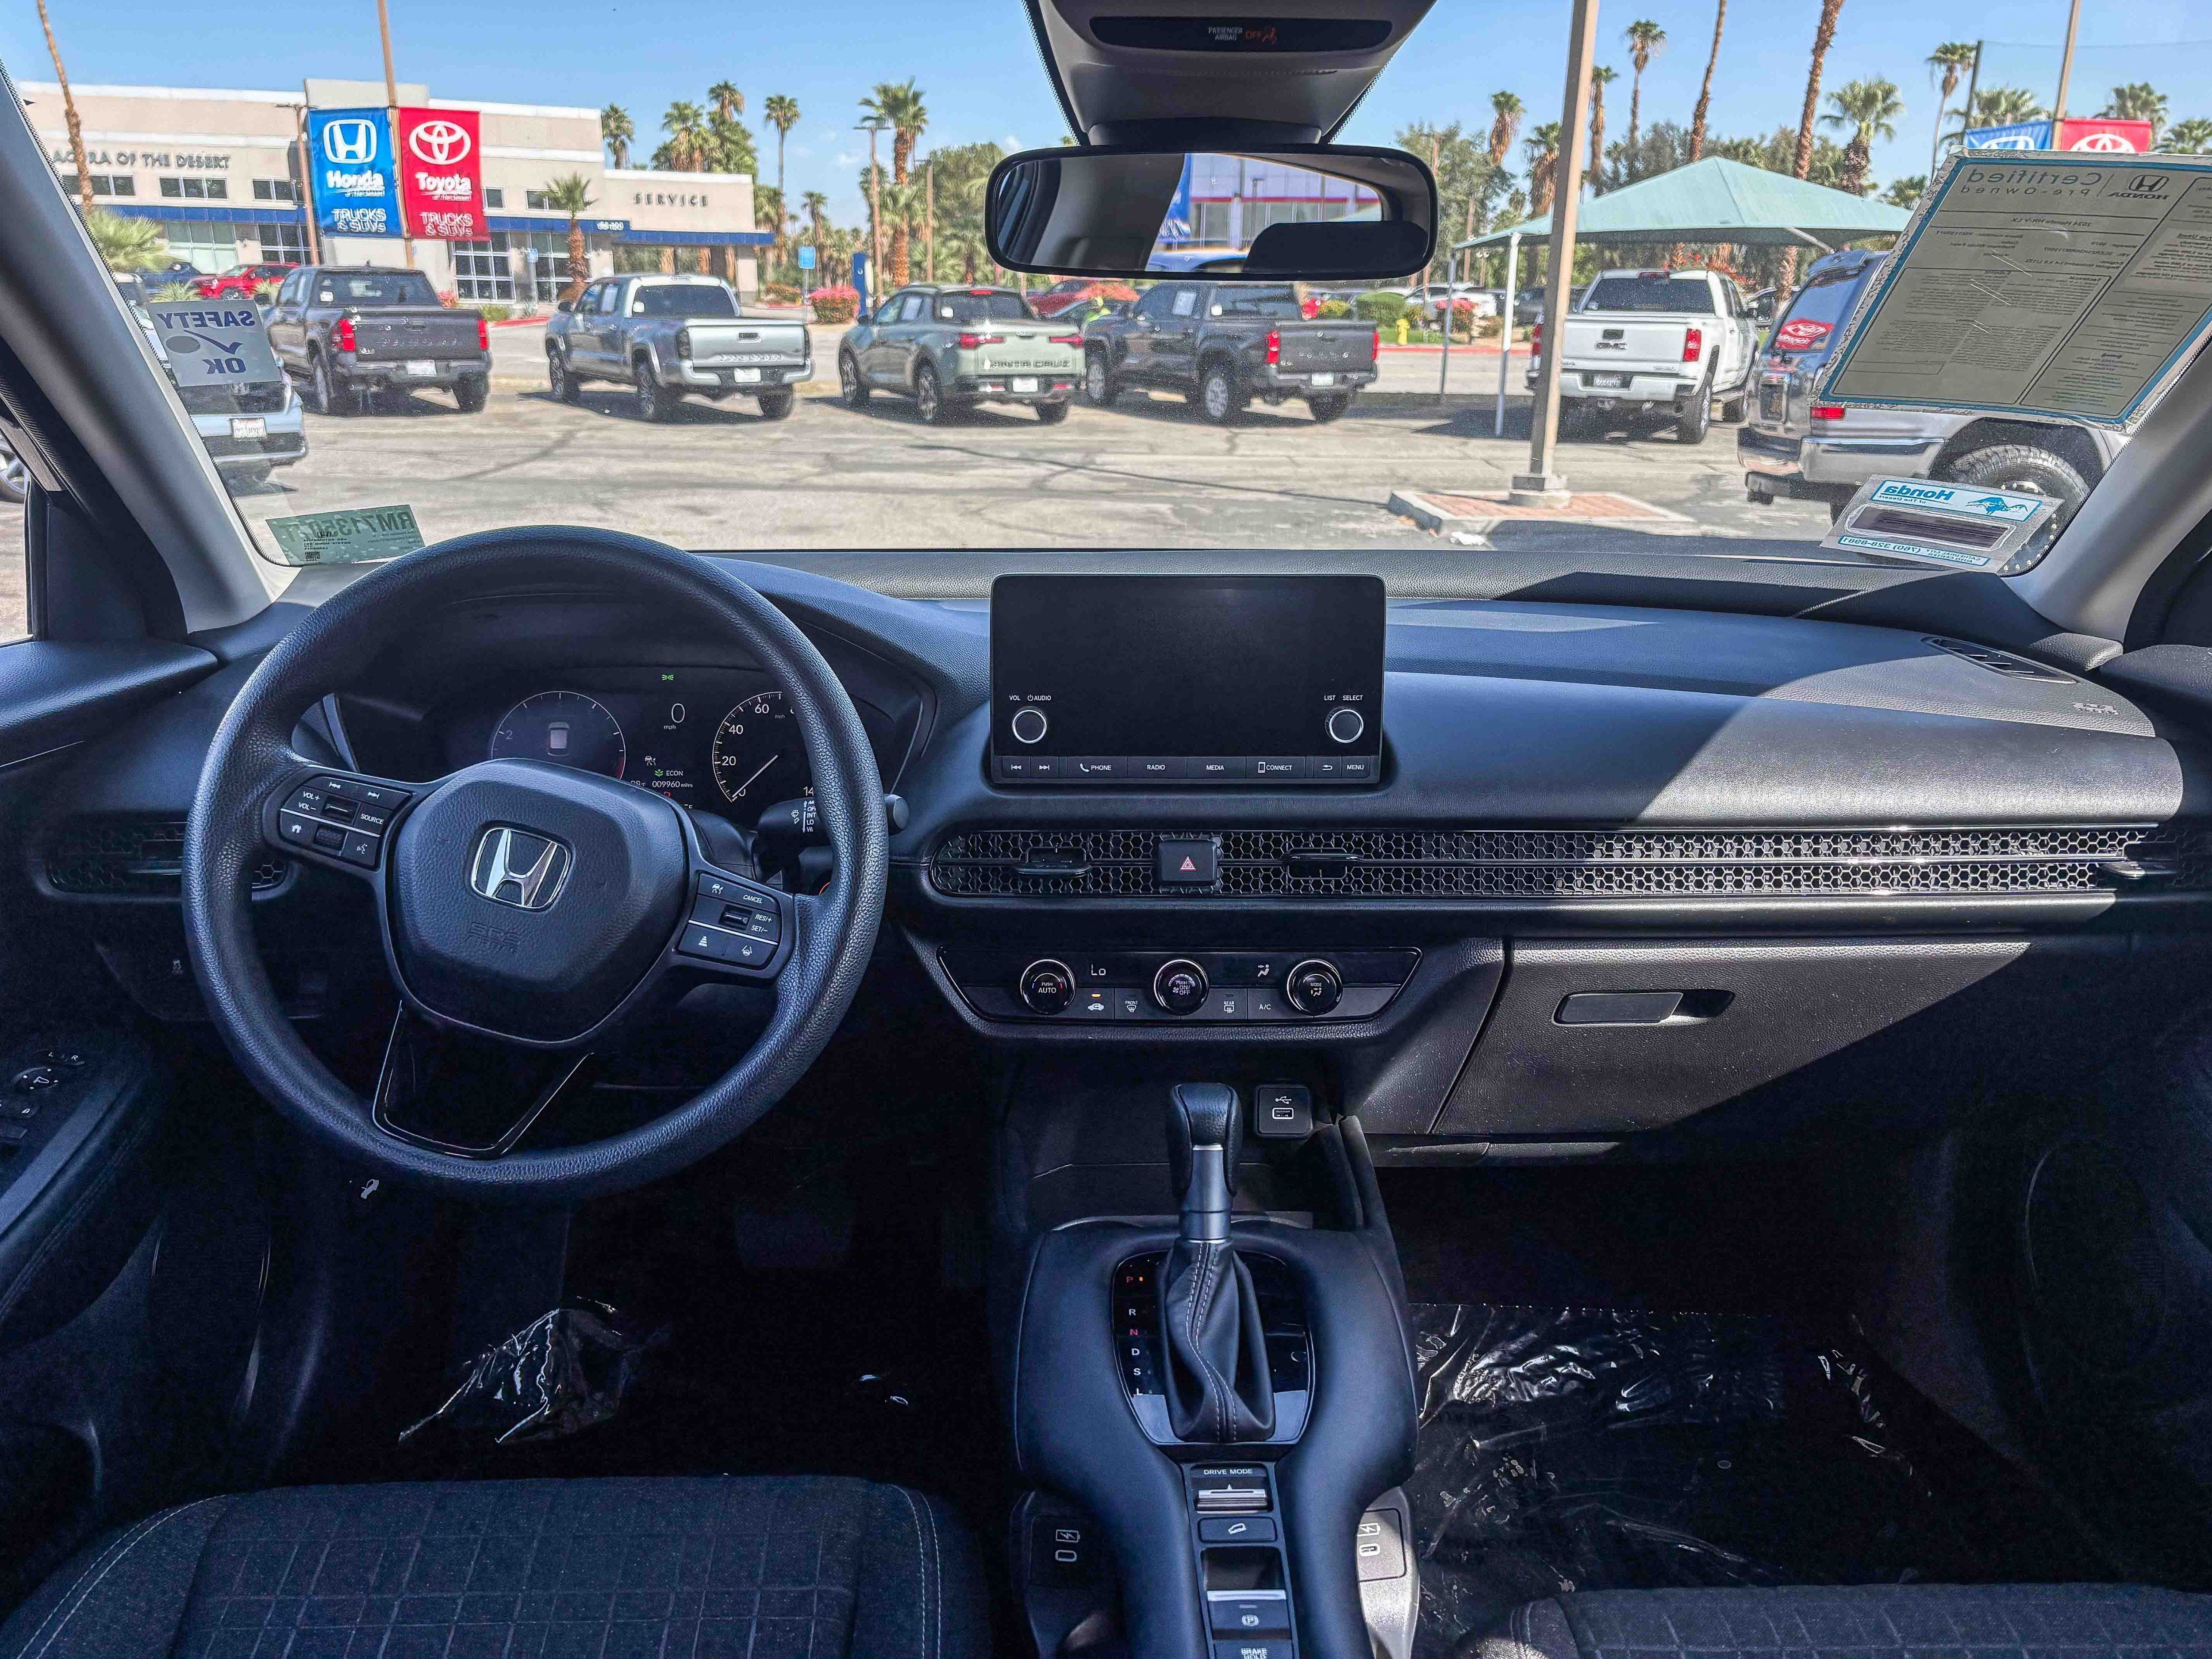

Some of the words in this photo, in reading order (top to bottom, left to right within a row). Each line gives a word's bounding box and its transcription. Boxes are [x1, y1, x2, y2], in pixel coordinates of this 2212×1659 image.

[54, 150, 111, 165] ACRA
[142, 154, 170, 167] THE
[177, 154, 230, 169] DESERT
[326, 170, 384, 188] Honda
[415, 172, 472, 193] Toyota
[634, 192, 708, 207] SERVICE
[332, 208, 386, 222] TRUCKS
[419, 211, 472, 226] TRUCKS
[337, 222, 348, 231] &
[425, 223, 438, 235] &
[671, 703, 685, 723] 0
[755, 704, 769, 714] 60
[505, 730, 512, 740] 2
[729, 725, 743, 734] 40
[722, 756, 736, 766] 20
[303, 791, 320, 801] VOL+
[361, 813, 384, 825] SOURCE
[743, 895, 762, 903] CANCEL
[755, 914, 772, 922] RES/+
